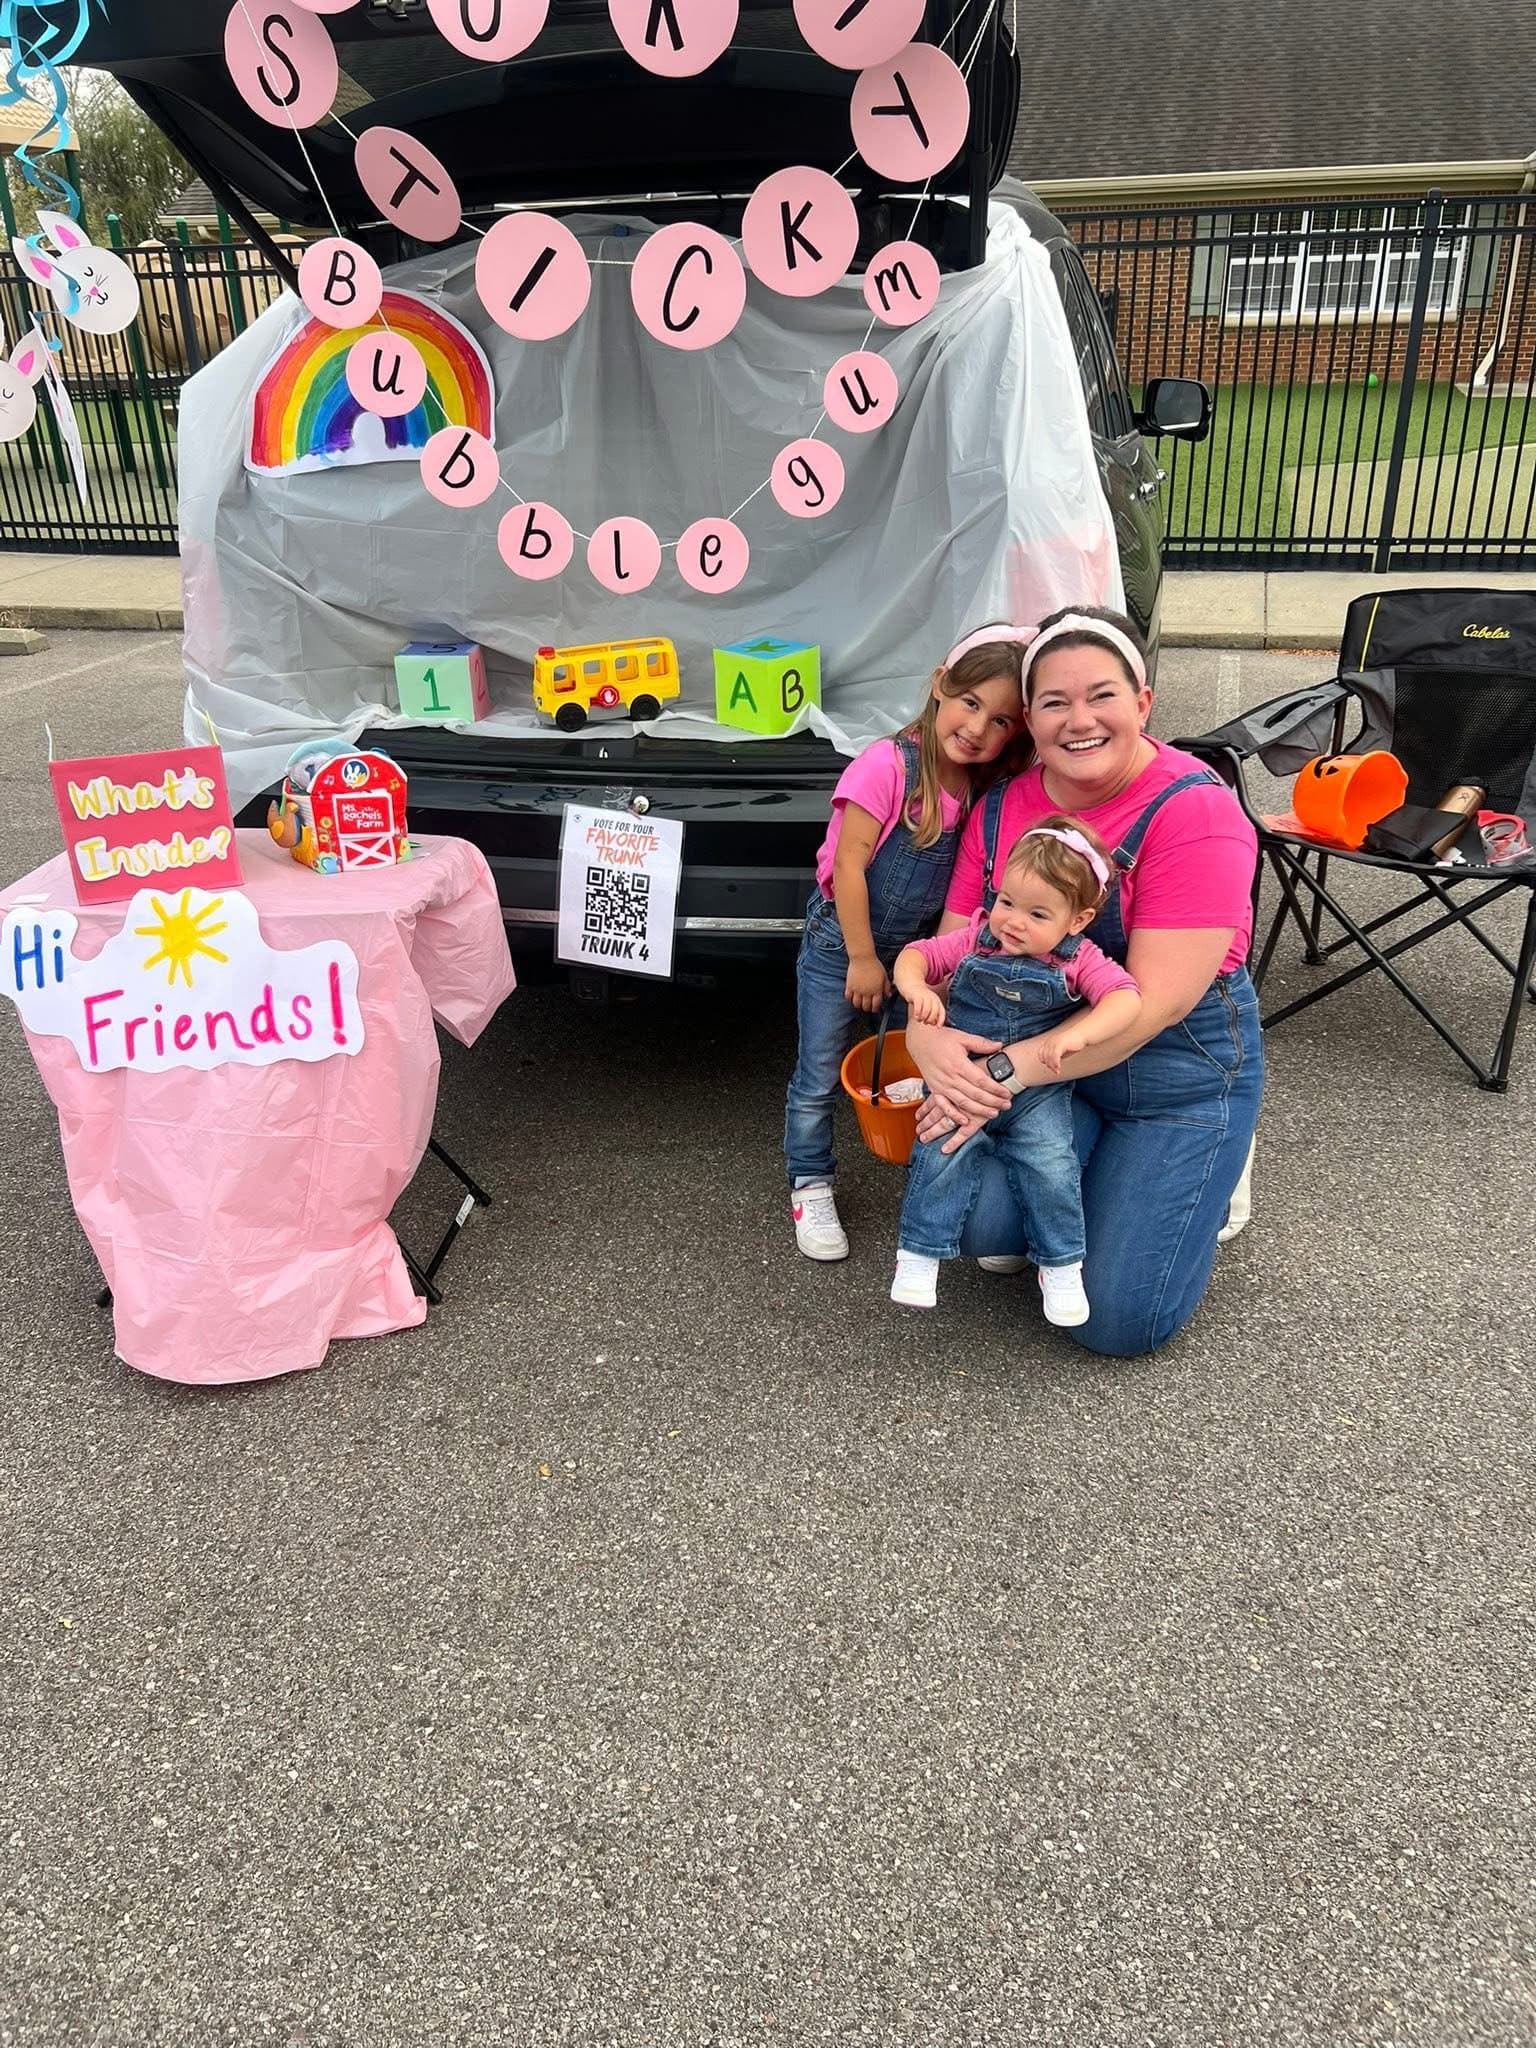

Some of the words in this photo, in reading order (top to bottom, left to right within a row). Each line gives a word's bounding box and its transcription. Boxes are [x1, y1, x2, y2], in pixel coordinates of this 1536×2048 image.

[426, 643, 457, 653] 5
[423, 667, 451, 711] 1
[730, 671, 757, 714] A
[782, 669, 804, 713] B
[68, 766, 216, 820] What's
[343, 808, 383, 822] Rachel's
[357, 819, 385, 828] Farm
[594, 818, 613, 830] VOTE
[615, 821, 631, 832] FOR
[633, 824, 655, 835] YOUR
[586, 827, 661, 852] FAVORITE
[77, 827, 232, 880] Inside?
[595, 846, 647, 868] TRUNK
[14, 924, 64, 992] Hi
[581, 934, 636, 960] TRUNK
[638, 944, 650, 961] 4
